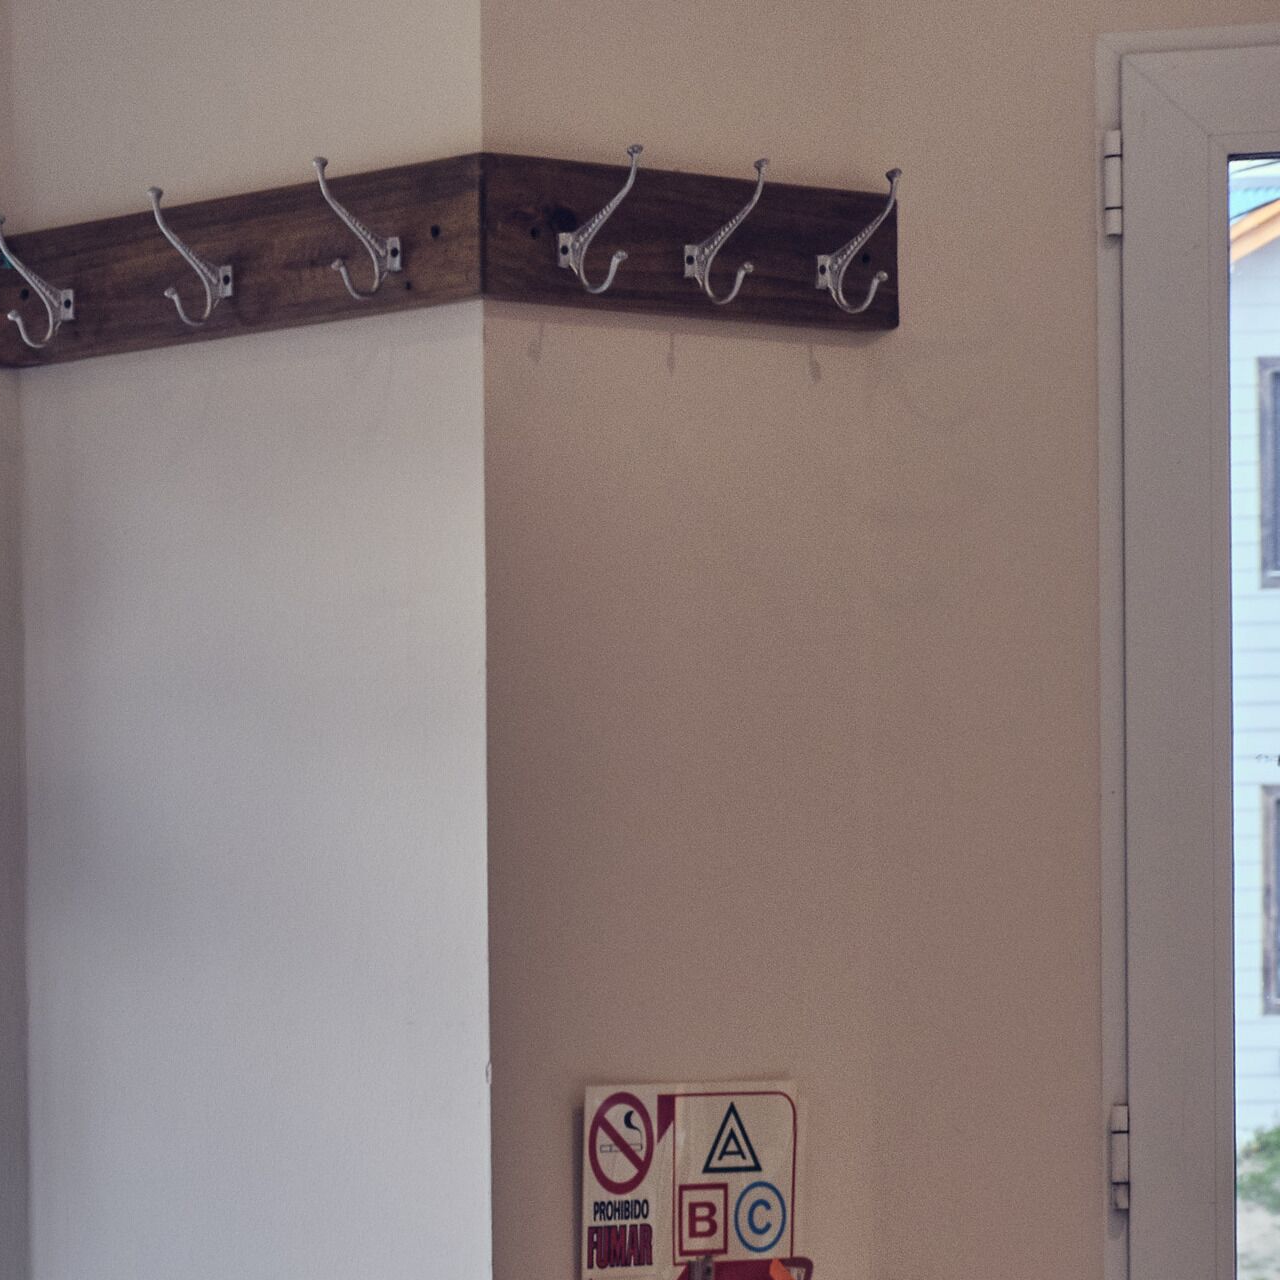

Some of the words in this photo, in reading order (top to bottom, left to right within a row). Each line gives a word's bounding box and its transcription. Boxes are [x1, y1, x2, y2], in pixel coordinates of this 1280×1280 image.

[593, 1198, 650, 1222] PROHIBIDO
[688, 1201, 719, 1238] B
[747, 1198, 772, 1235] C
[587, 1223, 653, 1270] FUMAR
